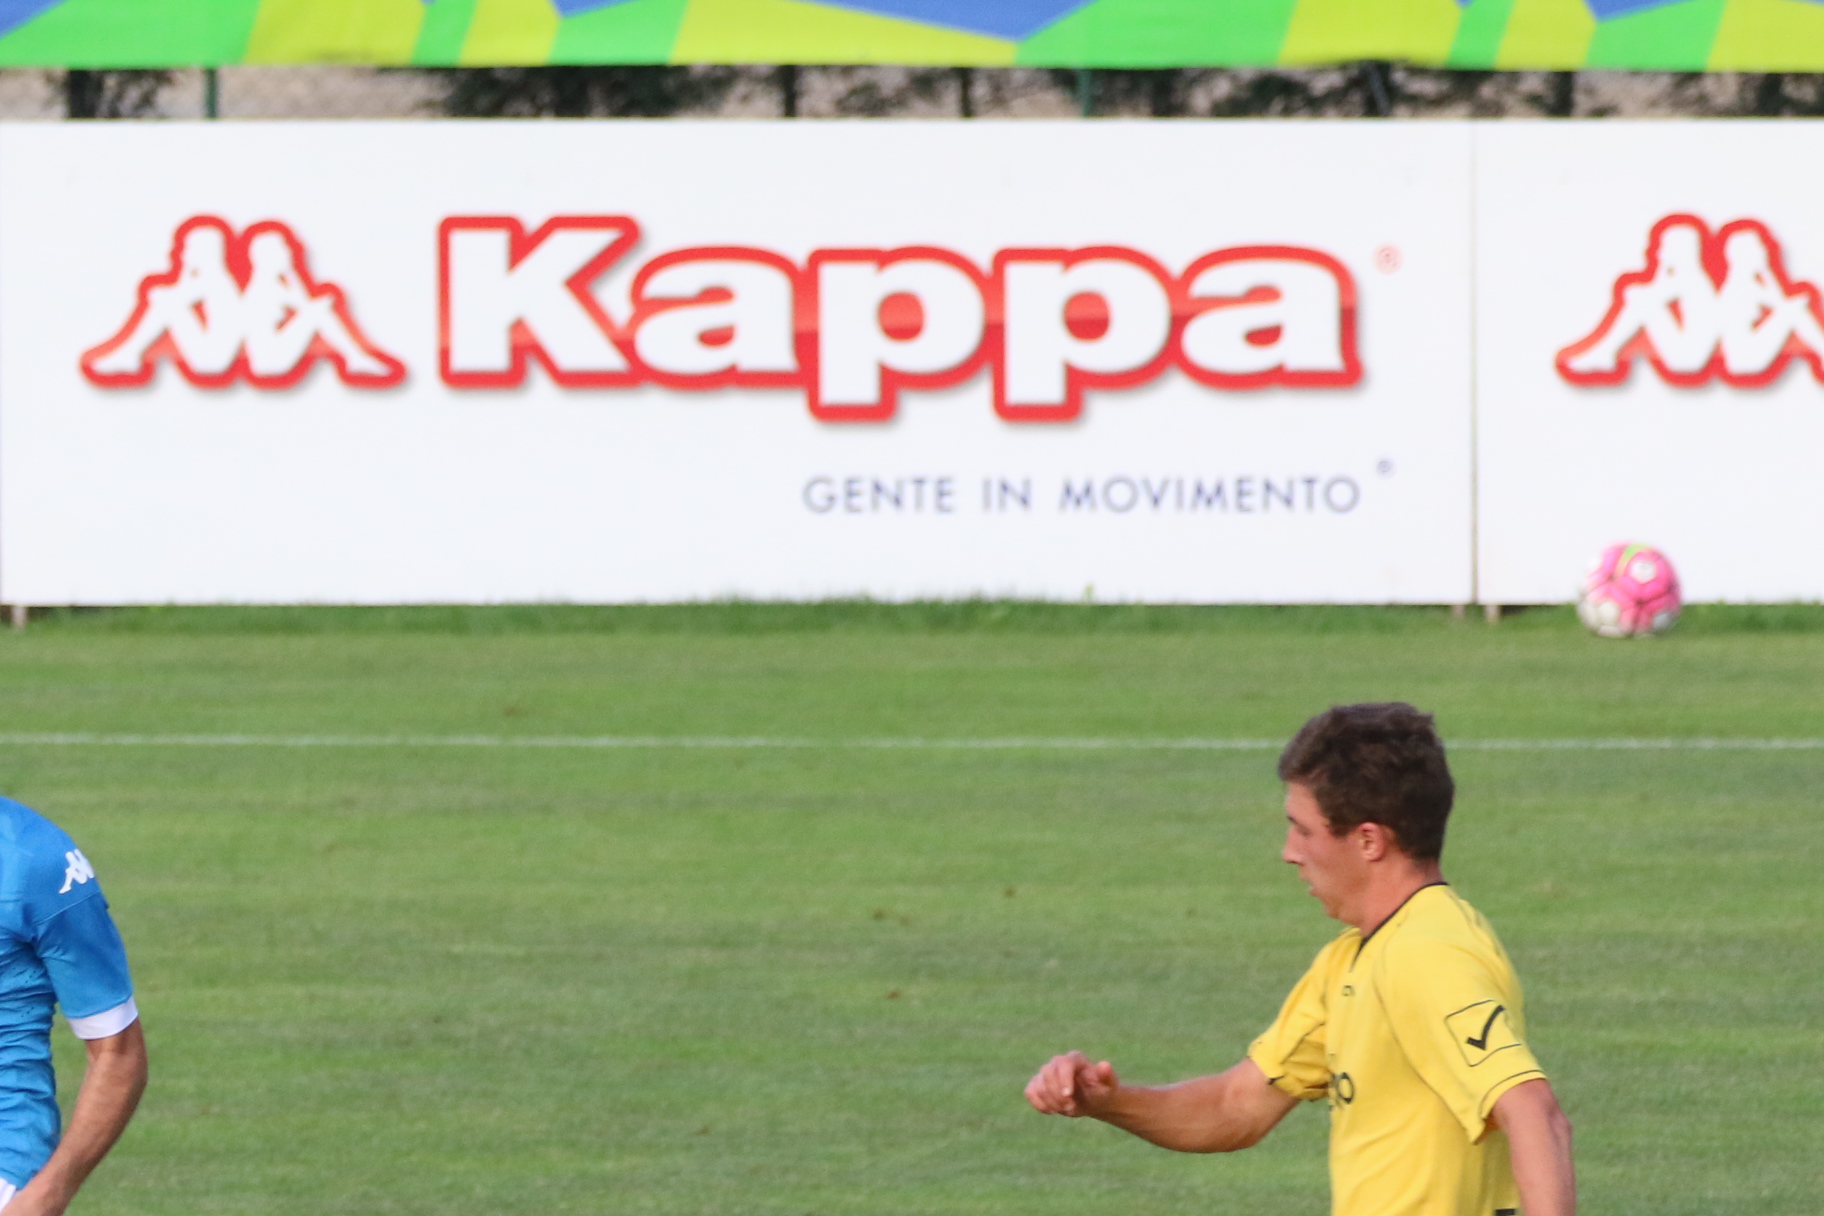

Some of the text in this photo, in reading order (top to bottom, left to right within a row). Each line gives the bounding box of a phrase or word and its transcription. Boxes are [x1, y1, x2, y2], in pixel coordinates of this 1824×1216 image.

[438, 214, 1367, 421] Kappa
[802, 475, 1361, 514] GENTE IN MOVIMENTO
